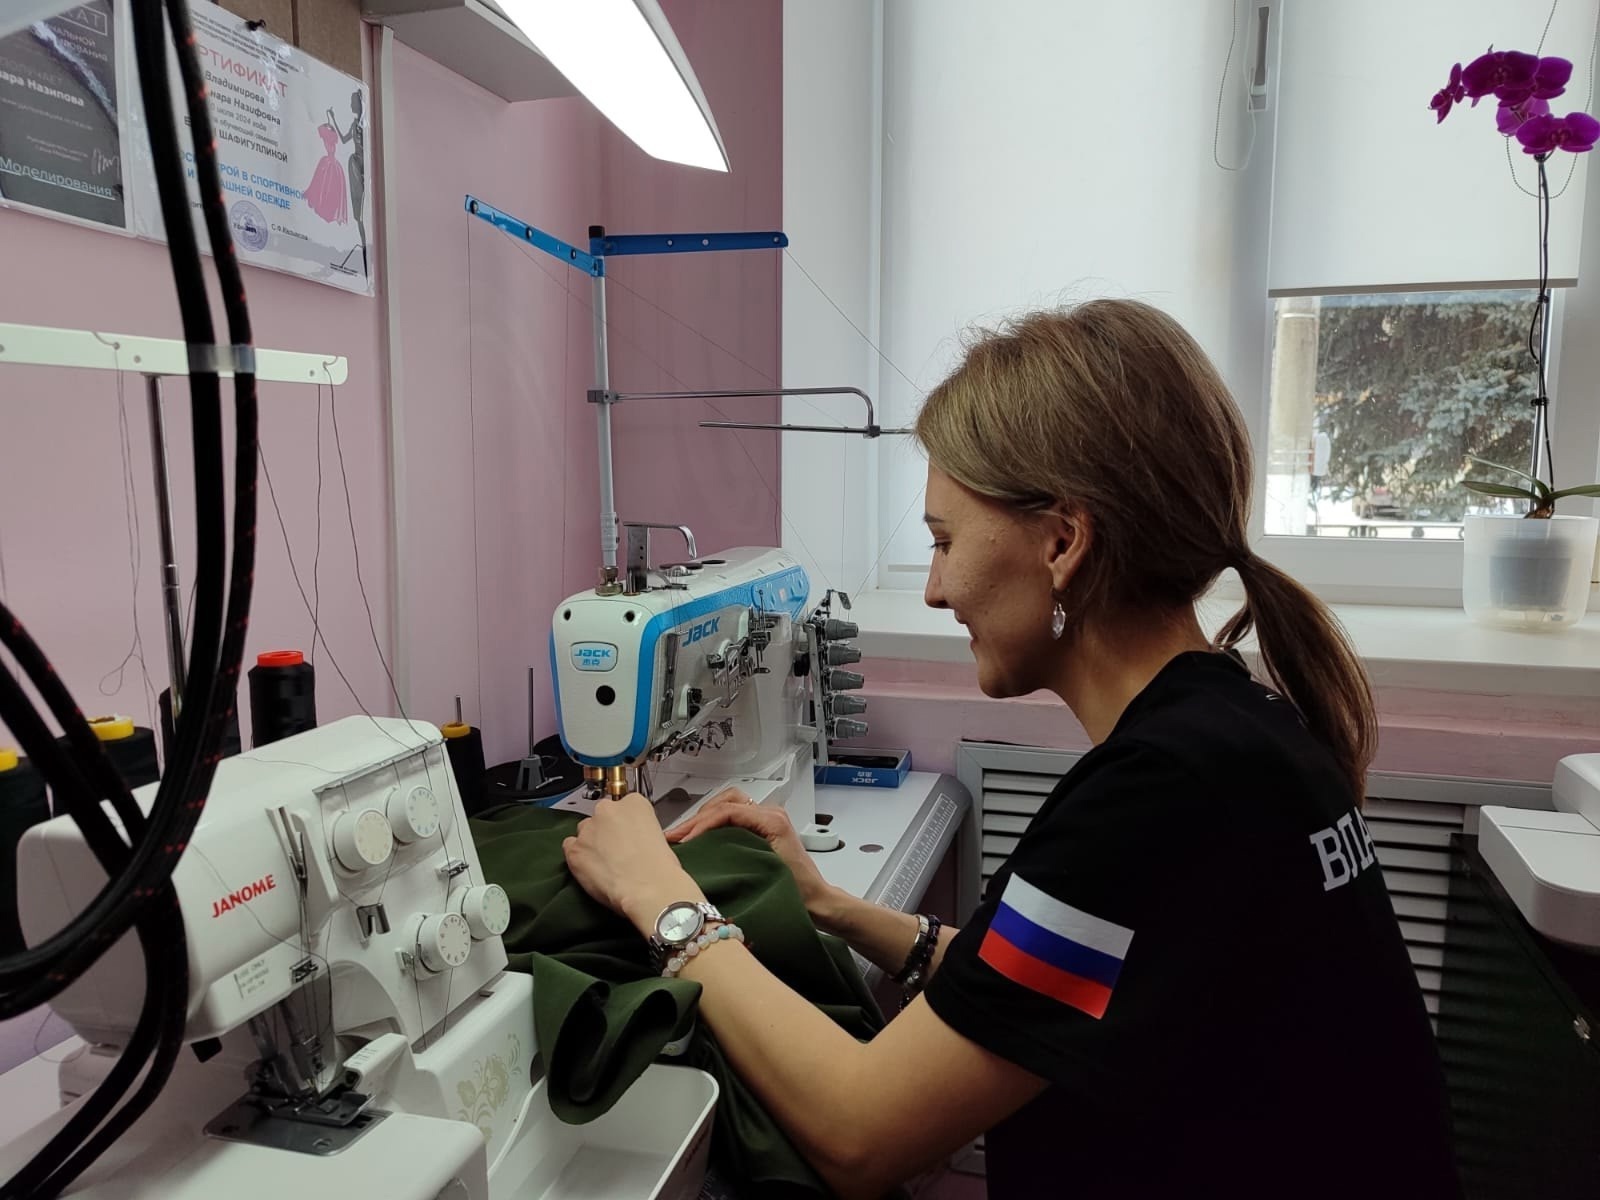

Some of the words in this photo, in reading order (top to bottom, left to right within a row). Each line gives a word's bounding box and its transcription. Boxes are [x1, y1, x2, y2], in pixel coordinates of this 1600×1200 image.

[205, 70, 265, 104] Владимирова
[218, 129, 288, 163] ШАФИГУЛЛИНОЙ
[0, 157, 113, 197] Моделирования
[218, 162, 240, 178] РОЙ
[242, 170, 249, 181] В
[255, 190, 292, 209] ОДЕЖДЕ
[212, 874, 277, 918] JANOME
